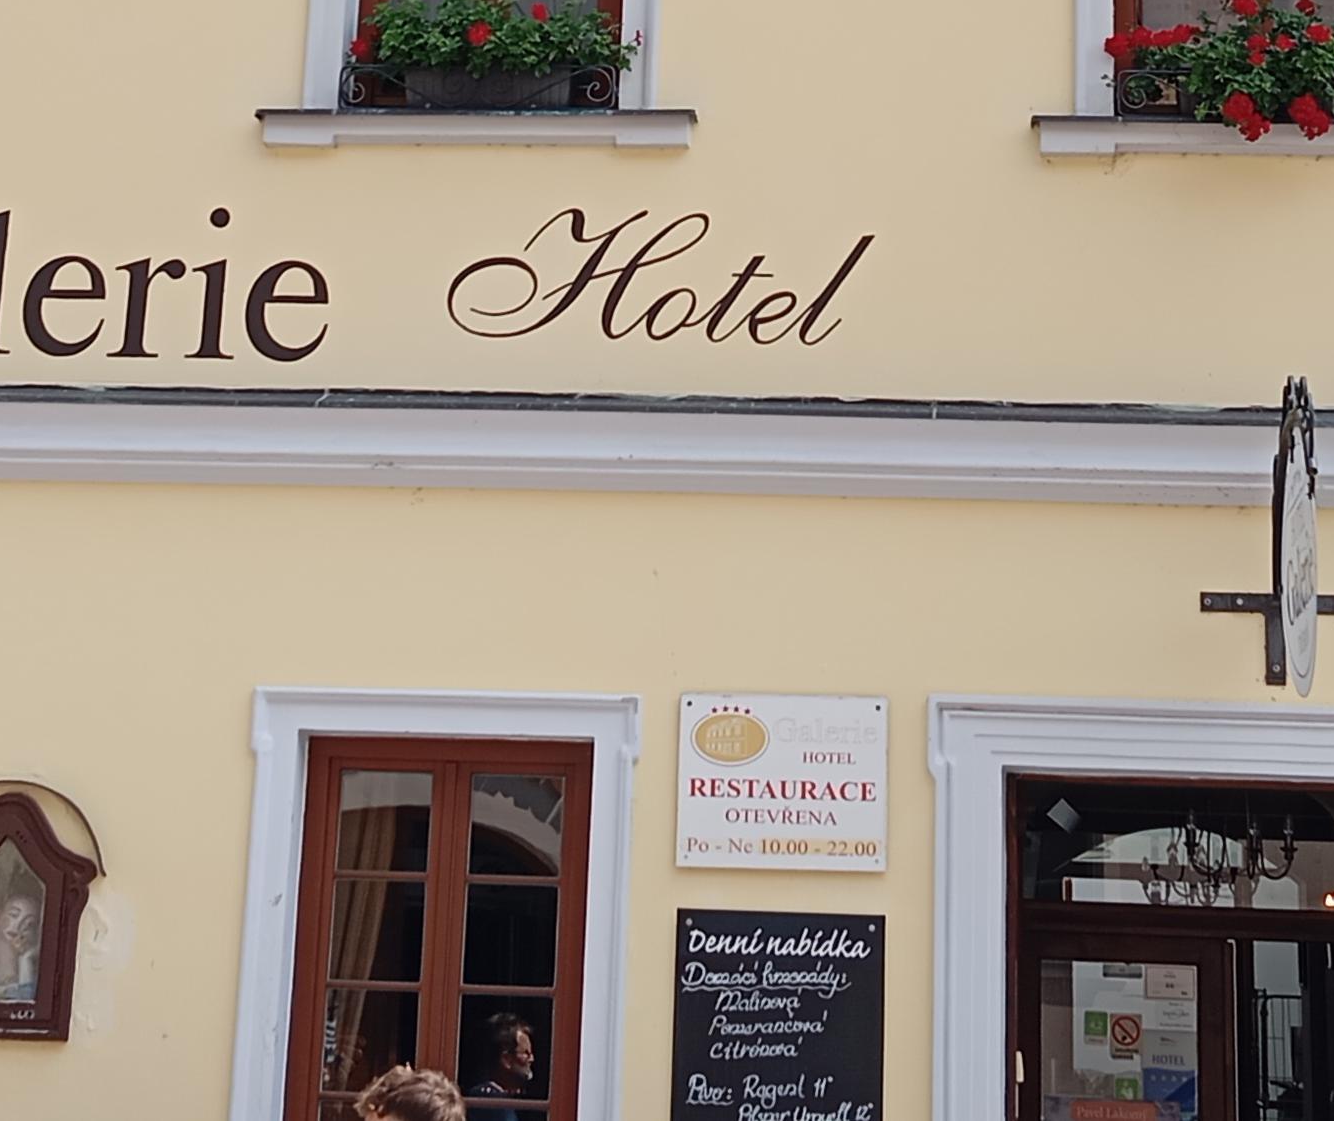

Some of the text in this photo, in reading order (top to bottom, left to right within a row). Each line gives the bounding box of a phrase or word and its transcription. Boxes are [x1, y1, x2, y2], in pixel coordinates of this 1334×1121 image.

[446, 206, 876, 346] Hotel
[773, 716, 878, 744] Galerie
[802, 751, 857, 765] HOTEL
[688, 777, 877, 802] RESTAURACE
[724, 806, 838, 826] OTEVŘENA
[686, 837, 710, 853] Po
[728, 838, 754, 855] Ne
[760, 839, 809, 856] 10.00
[827, 840, 877, 857] 22.00
[688, 928, 872, 959] Denní nabídka
[1152, 1053, 1186, 1066] HOTEL
